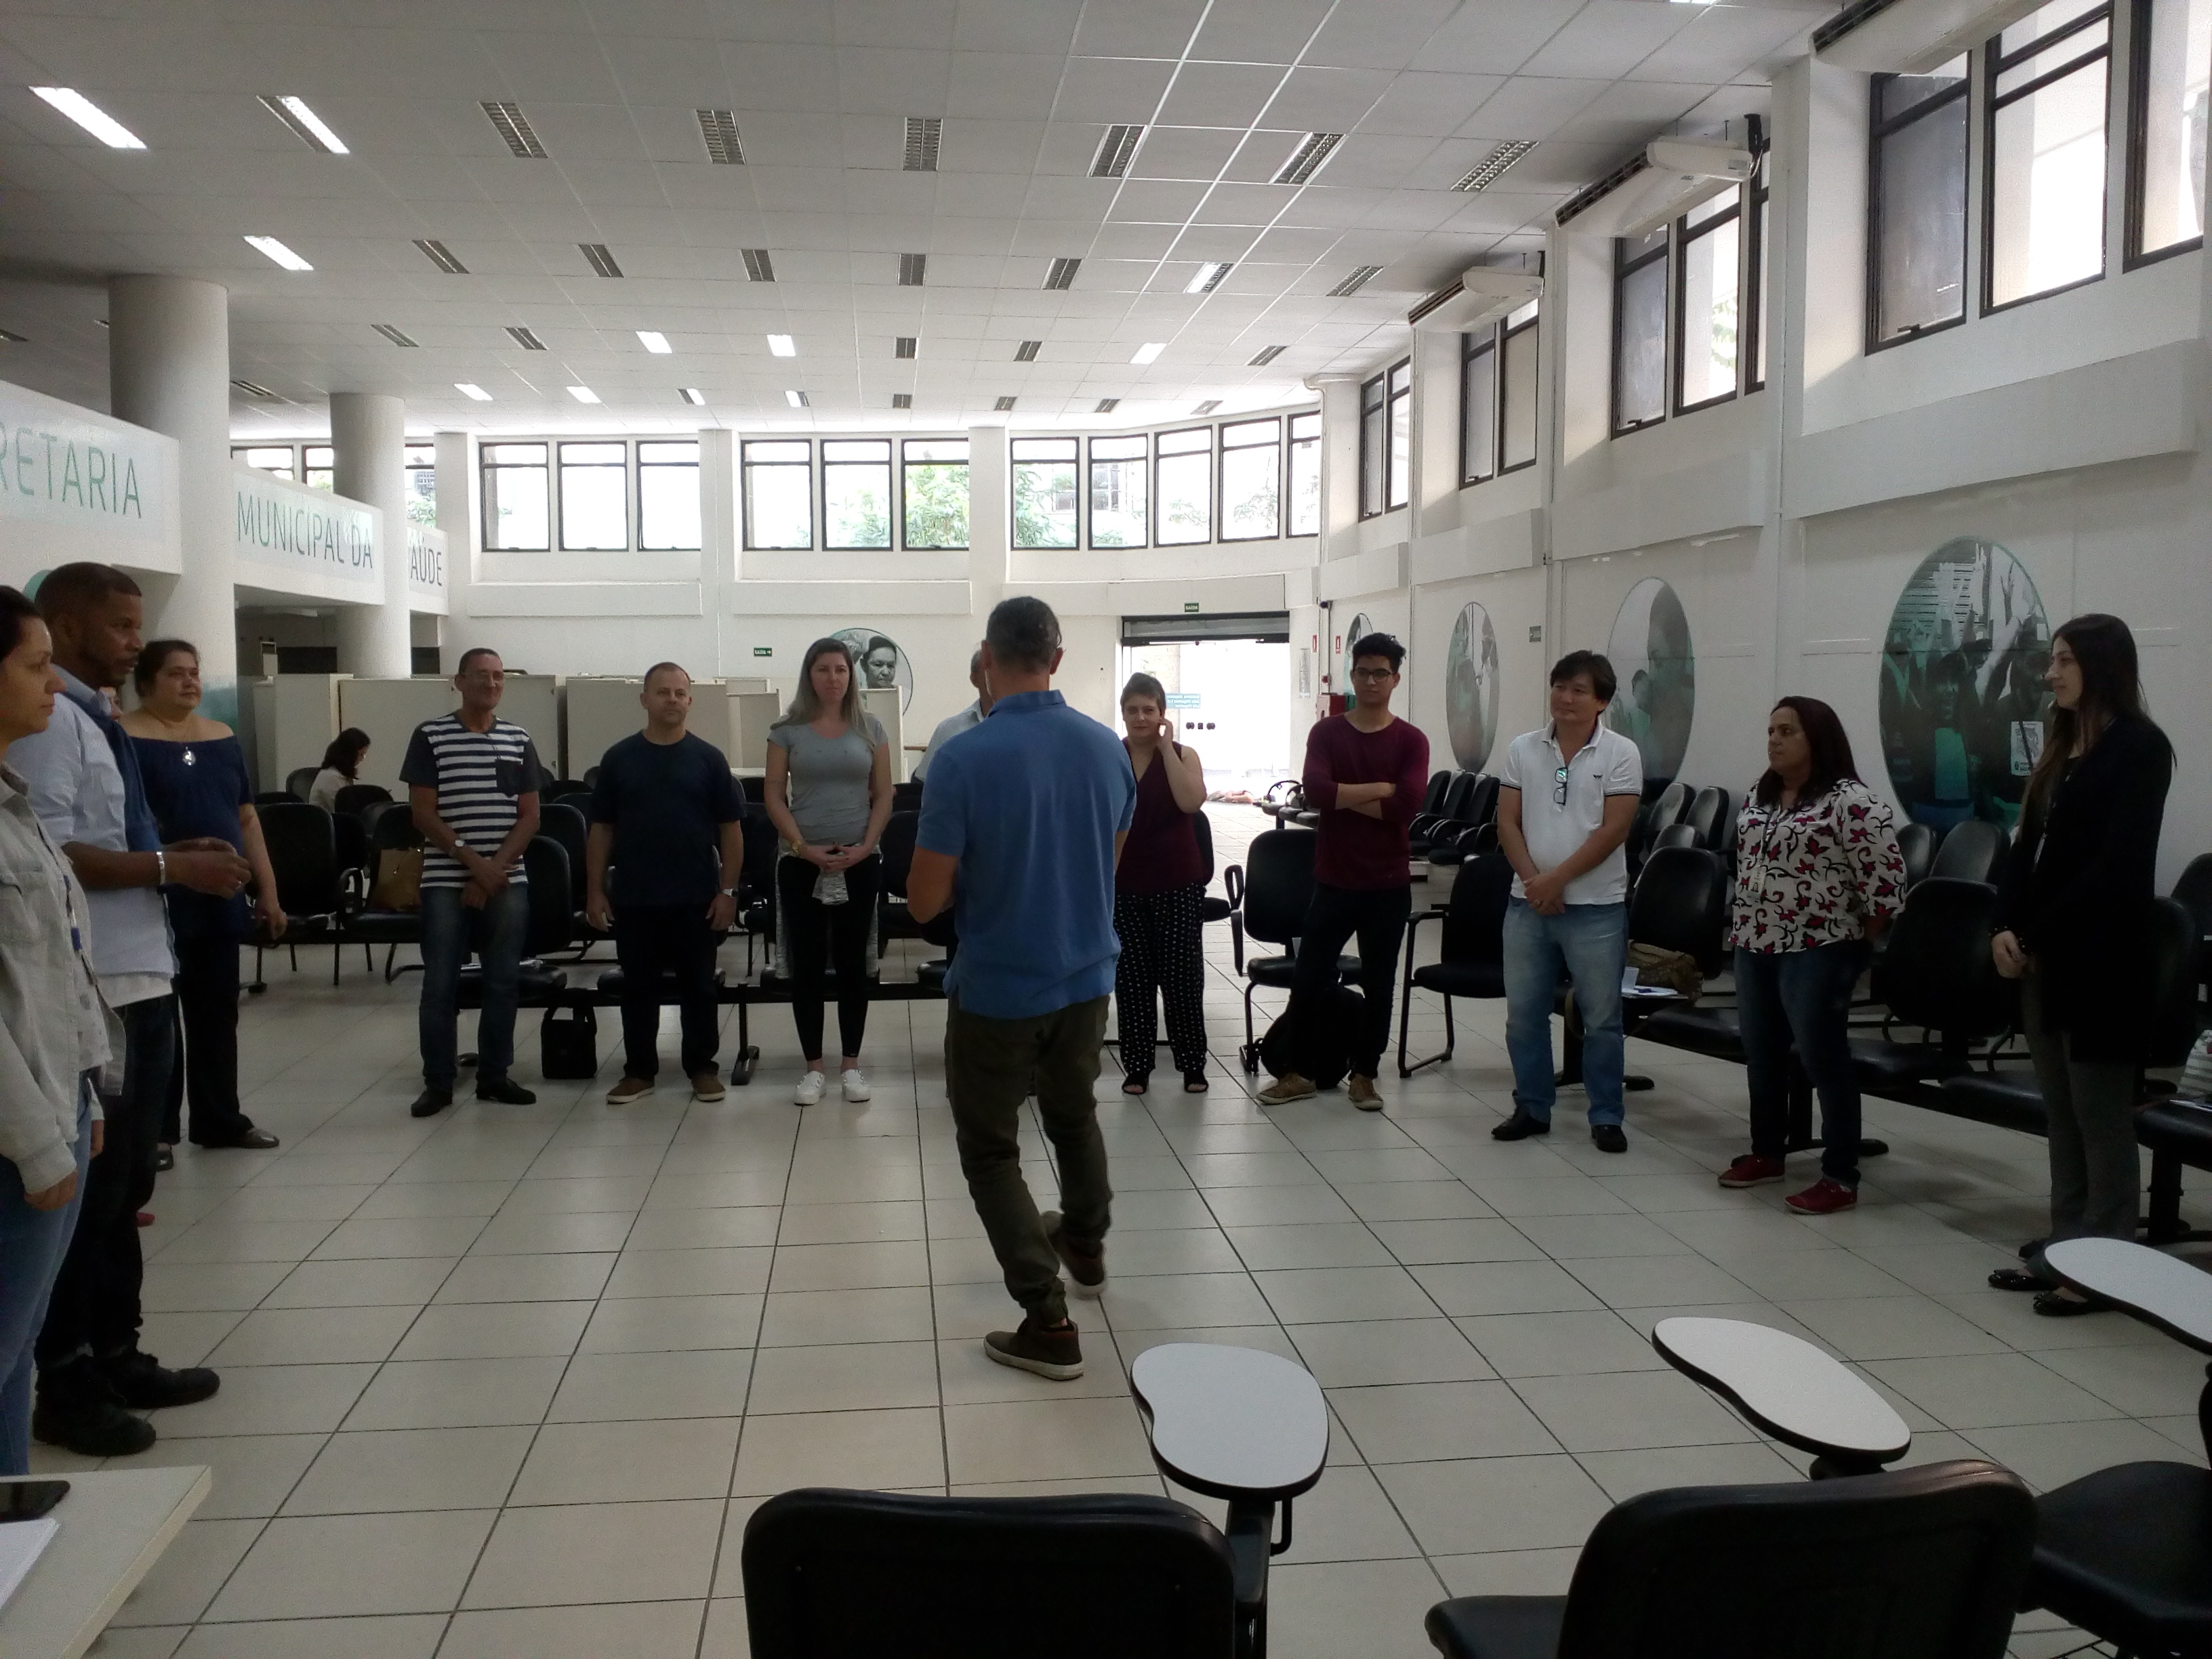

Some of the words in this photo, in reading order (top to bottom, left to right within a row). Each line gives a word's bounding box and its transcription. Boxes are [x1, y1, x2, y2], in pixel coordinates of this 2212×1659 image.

[237, 491, 344, 564] MUNICIPAL
[350, 525, 373, 569] DA
[408, 537, 443, 586] AÚDE
